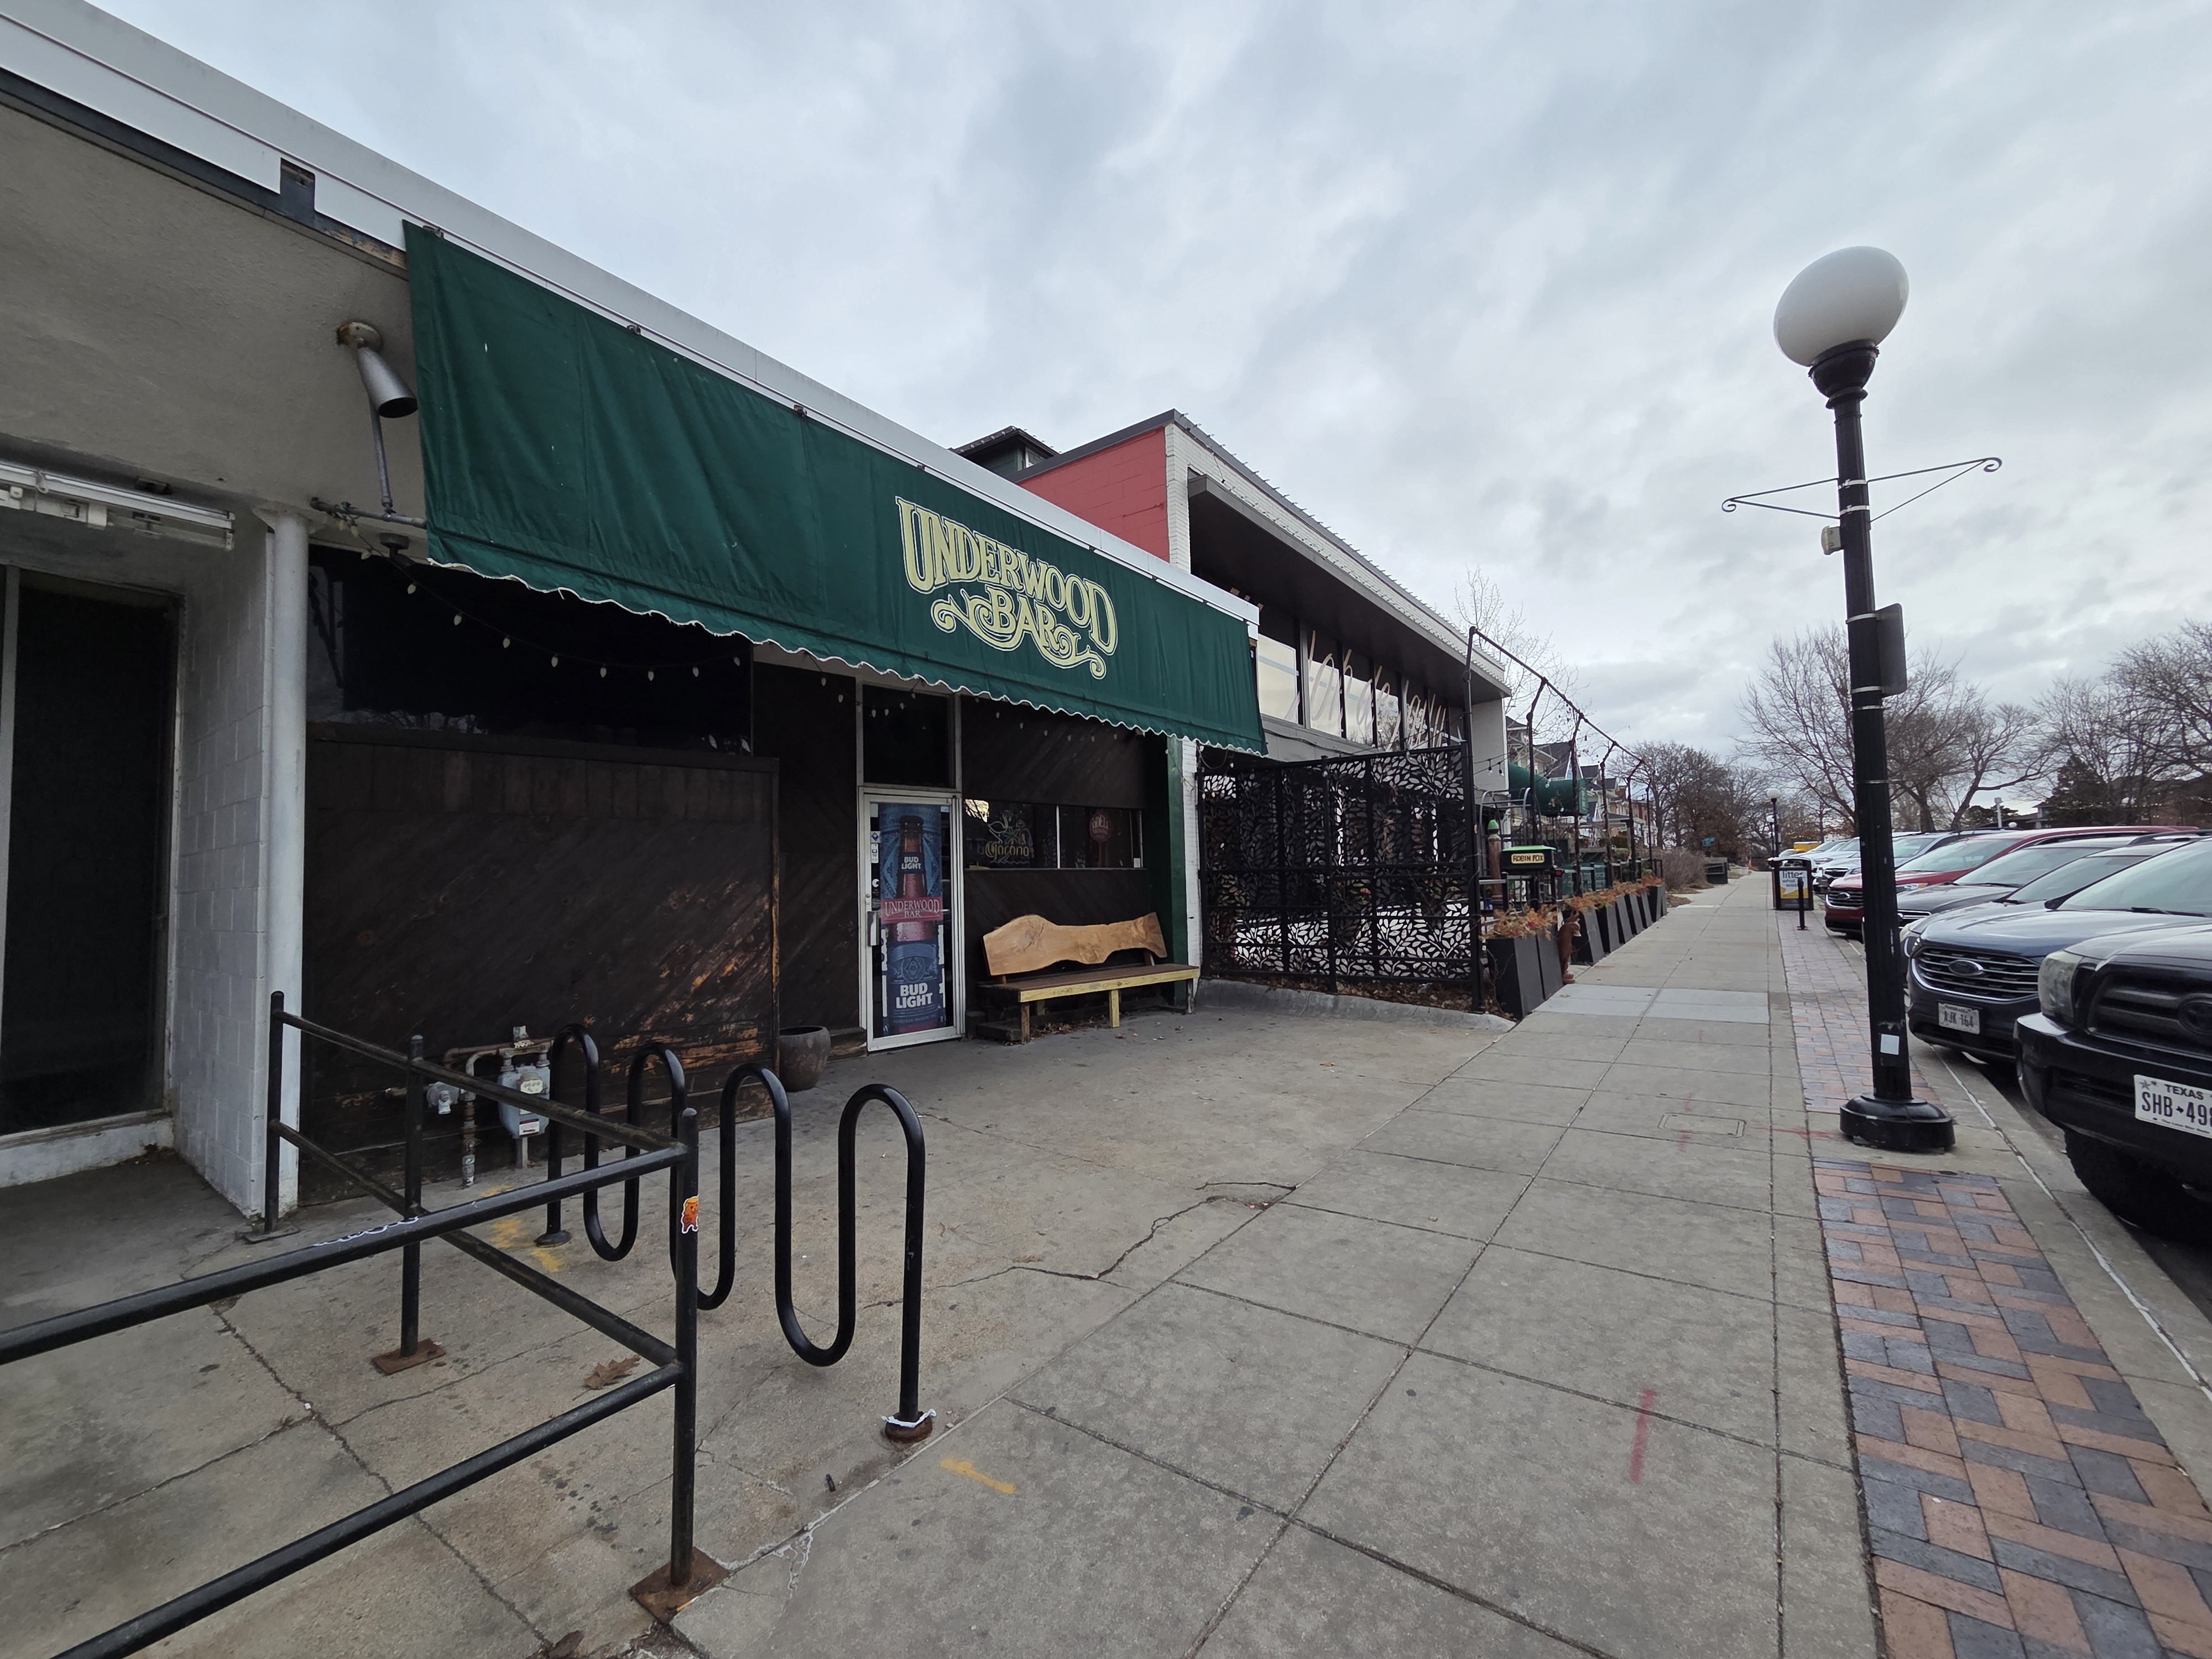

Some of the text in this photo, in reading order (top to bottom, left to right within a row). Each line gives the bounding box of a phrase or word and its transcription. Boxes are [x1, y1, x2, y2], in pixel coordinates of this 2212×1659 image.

[895, 495, 1118, 655] UNDERWOOD
[985, 841, 1029, 859] Corona
[885, 899, 940, 916] UNDERWOOD
[900, 983, 927, 997] BUD
[896, 993, 933, 1008] LIGHT
[2164, 1084, 2204, 1100] TEXAS
[2186, 1102, 2212, 1128] 49
